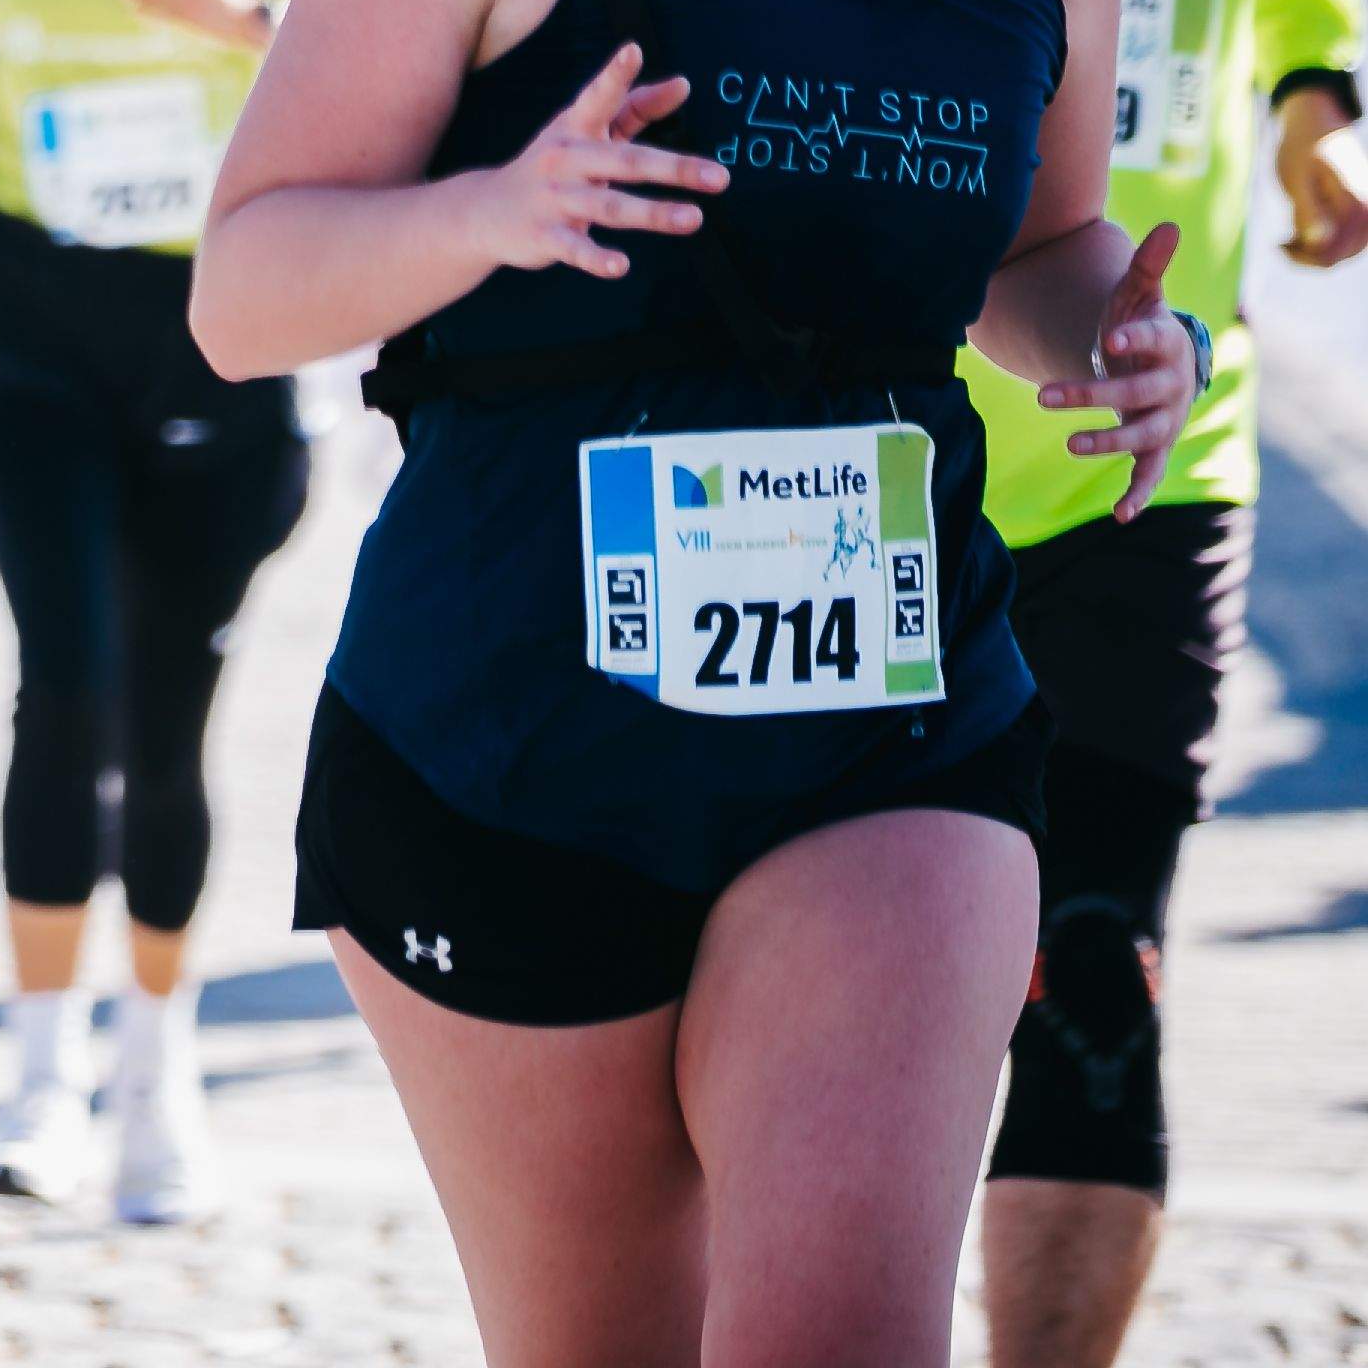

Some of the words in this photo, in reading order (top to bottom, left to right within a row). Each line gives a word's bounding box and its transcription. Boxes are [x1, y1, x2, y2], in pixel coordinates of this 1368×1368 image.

[719, 72, 855, 116] CAN'T
[879, 91, 989, 132] STOP
[717, 136, 831, 173] STOP
[737, 463, 868, 502] MetLife
[676, 529, 711, 553] VIII
[694, 596, 861, 688] 2714
